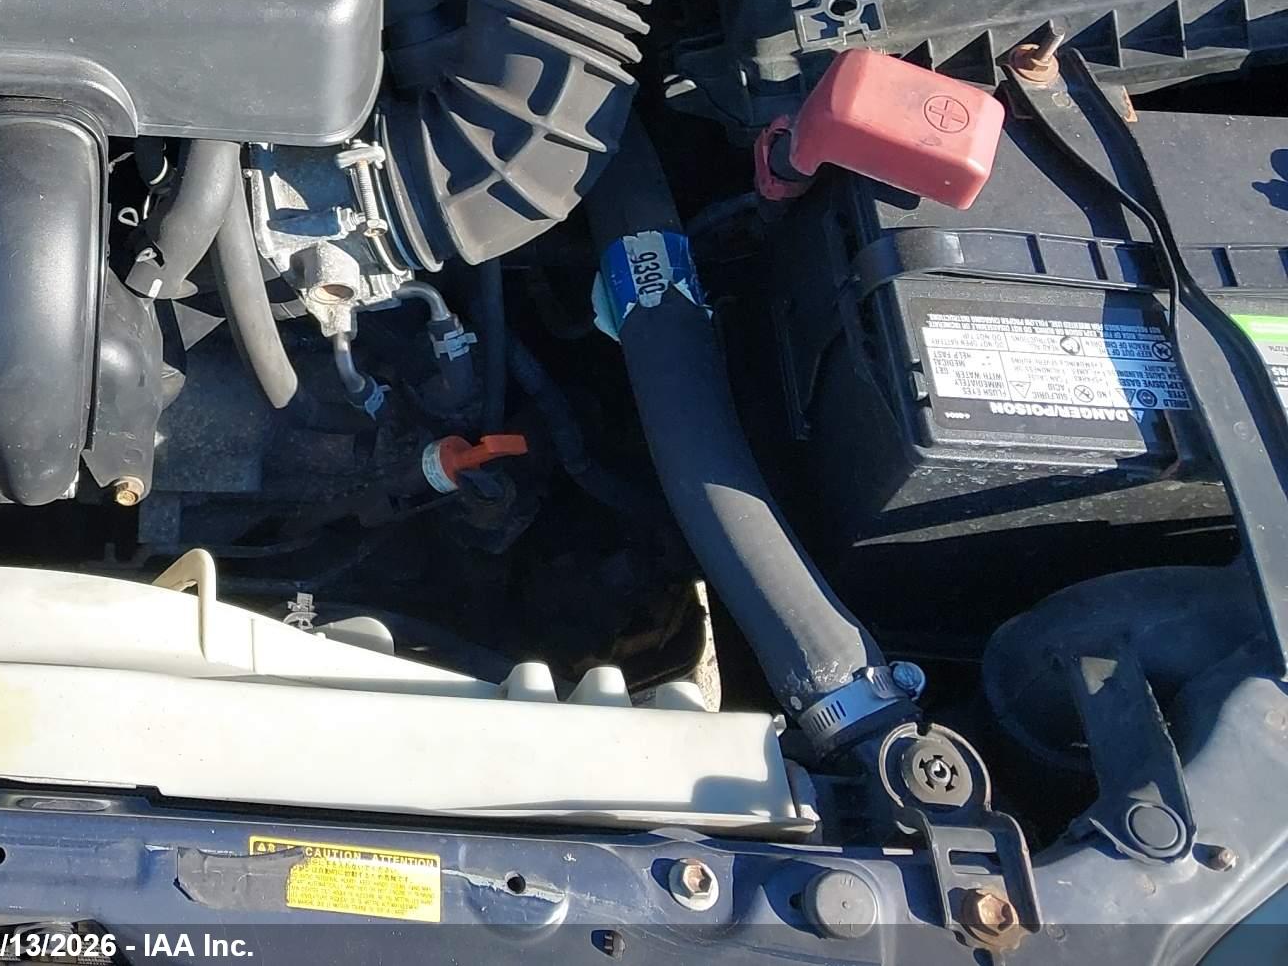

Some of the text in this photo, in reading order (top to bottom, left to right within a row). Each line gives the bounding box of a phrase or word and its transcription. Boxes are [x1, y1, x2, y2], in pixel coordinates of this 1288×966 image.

[990, 401, 1128, 422] DANGER/POISON
[305, 846, 362, 861] CAUTION
[373, 854, 435, 868] ATTENTION
